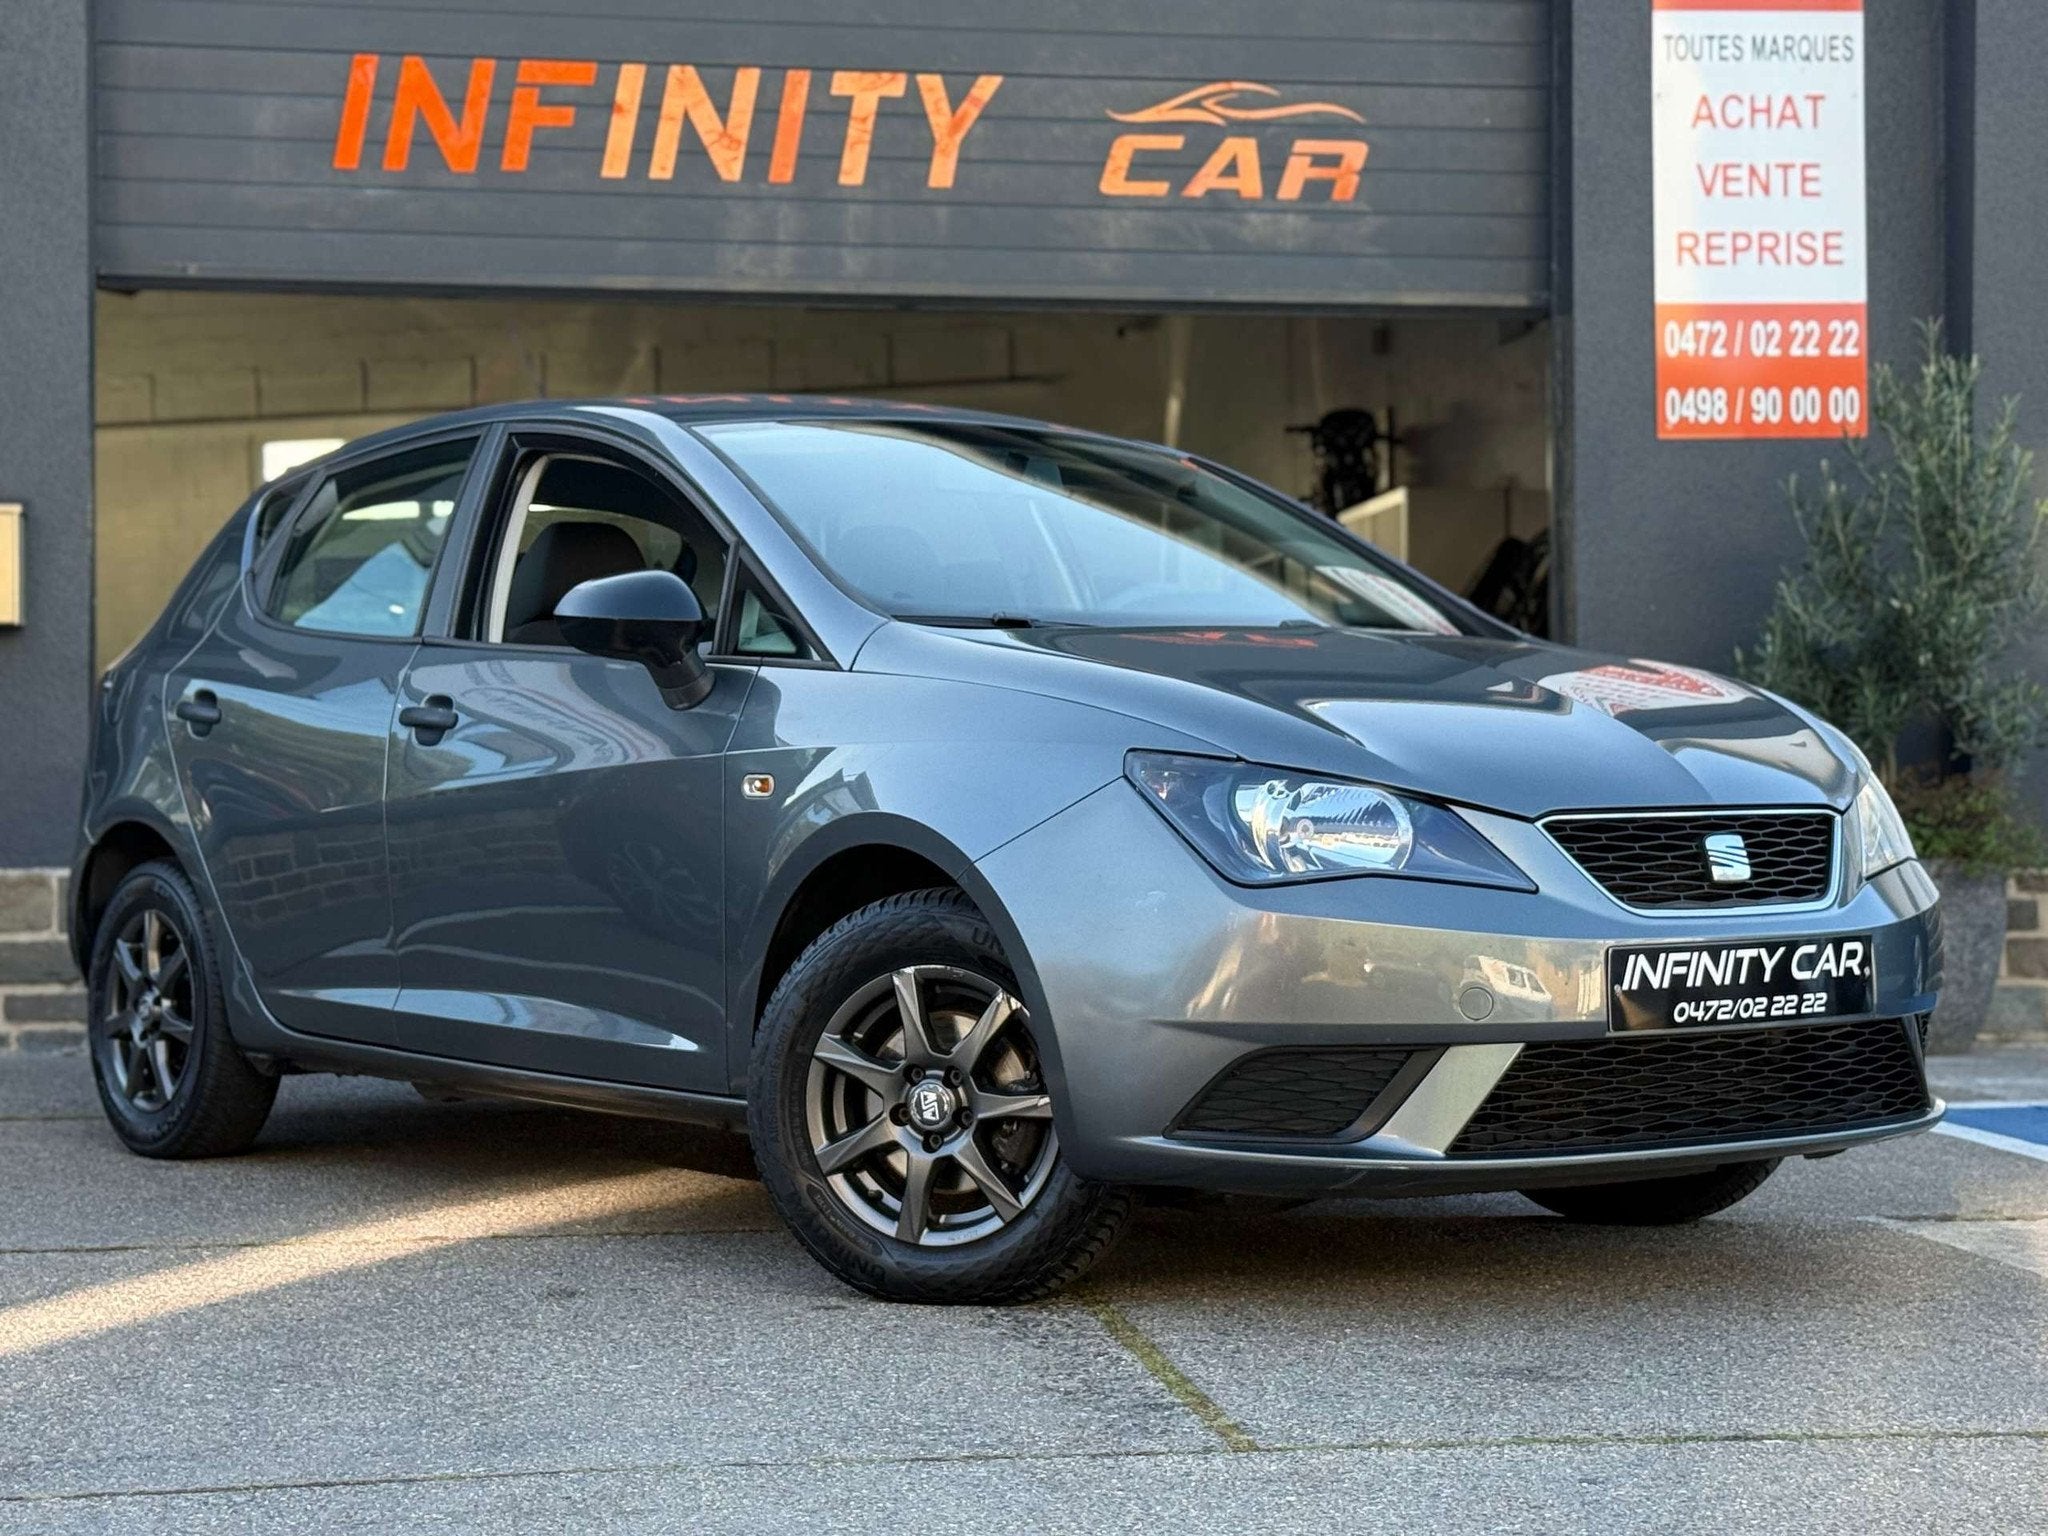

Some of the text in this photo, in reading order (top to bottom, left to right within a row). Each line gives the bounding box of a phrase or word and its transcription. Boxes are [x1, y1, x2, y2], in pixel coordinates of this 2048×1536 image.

[1664, 35, 1855, 63] TOUTES MARQUES
[332, 53, 1369, 201] INFINITY CAR
[1692, 94, 1826, 130] ACHAT
[1696, 163, 1822, 198] VENTE
[1675, 230, 1845, 267] REPRISE
[1788, 319, 1821, 358] 22
[1827, 319, 1860, 358] 22
[1789, 386, 1822, 425] 00
[1828, 386, 1860, 425] 00
[1621, 941, 1863, 991] INFINITY CAR
[1673, 991, 1828, 1024] 0472/02 22 22
